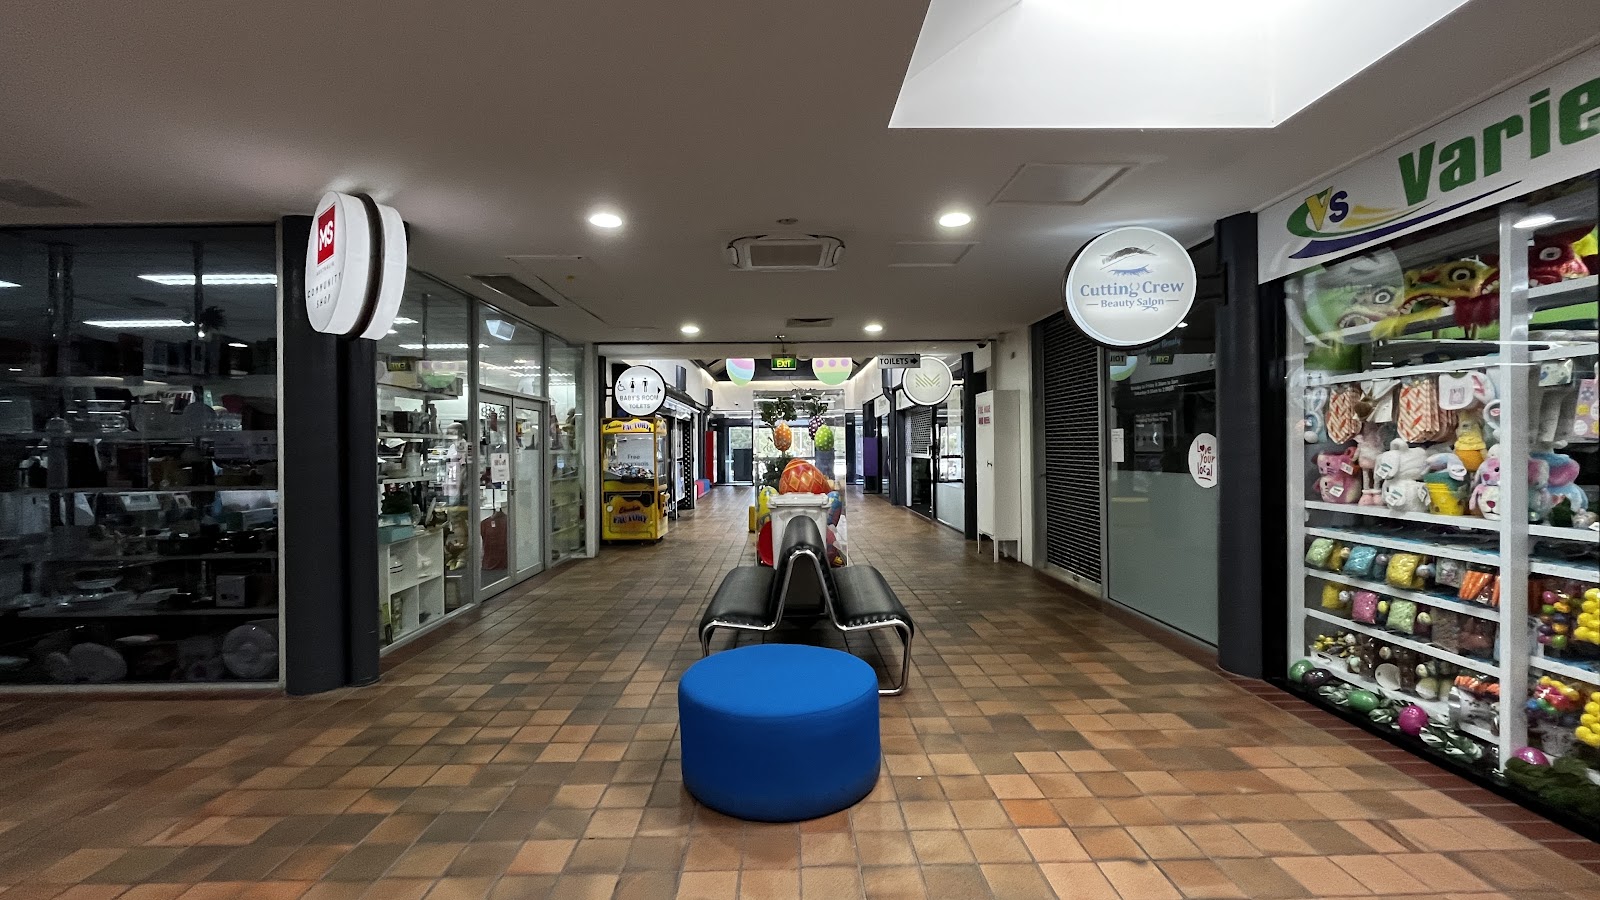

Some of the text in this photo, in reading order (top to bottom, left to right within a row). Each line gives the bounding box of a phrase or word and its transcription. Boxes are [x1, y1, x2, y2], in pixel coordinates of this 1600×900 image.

[1398, 77, 1600, 206] Varie
[319, 220, 334, 252] MS
[307, 272, 341, 299] COMMUNITY
[1080, 281, 1184, 298] Cutting Crew
[316, 294, 331, 309] SHOP
[1101, 297, 1164, 308] Beauty Salon
[880, 357, 909, 365] TOILETS
[1197, 462, 1213, 477] local
